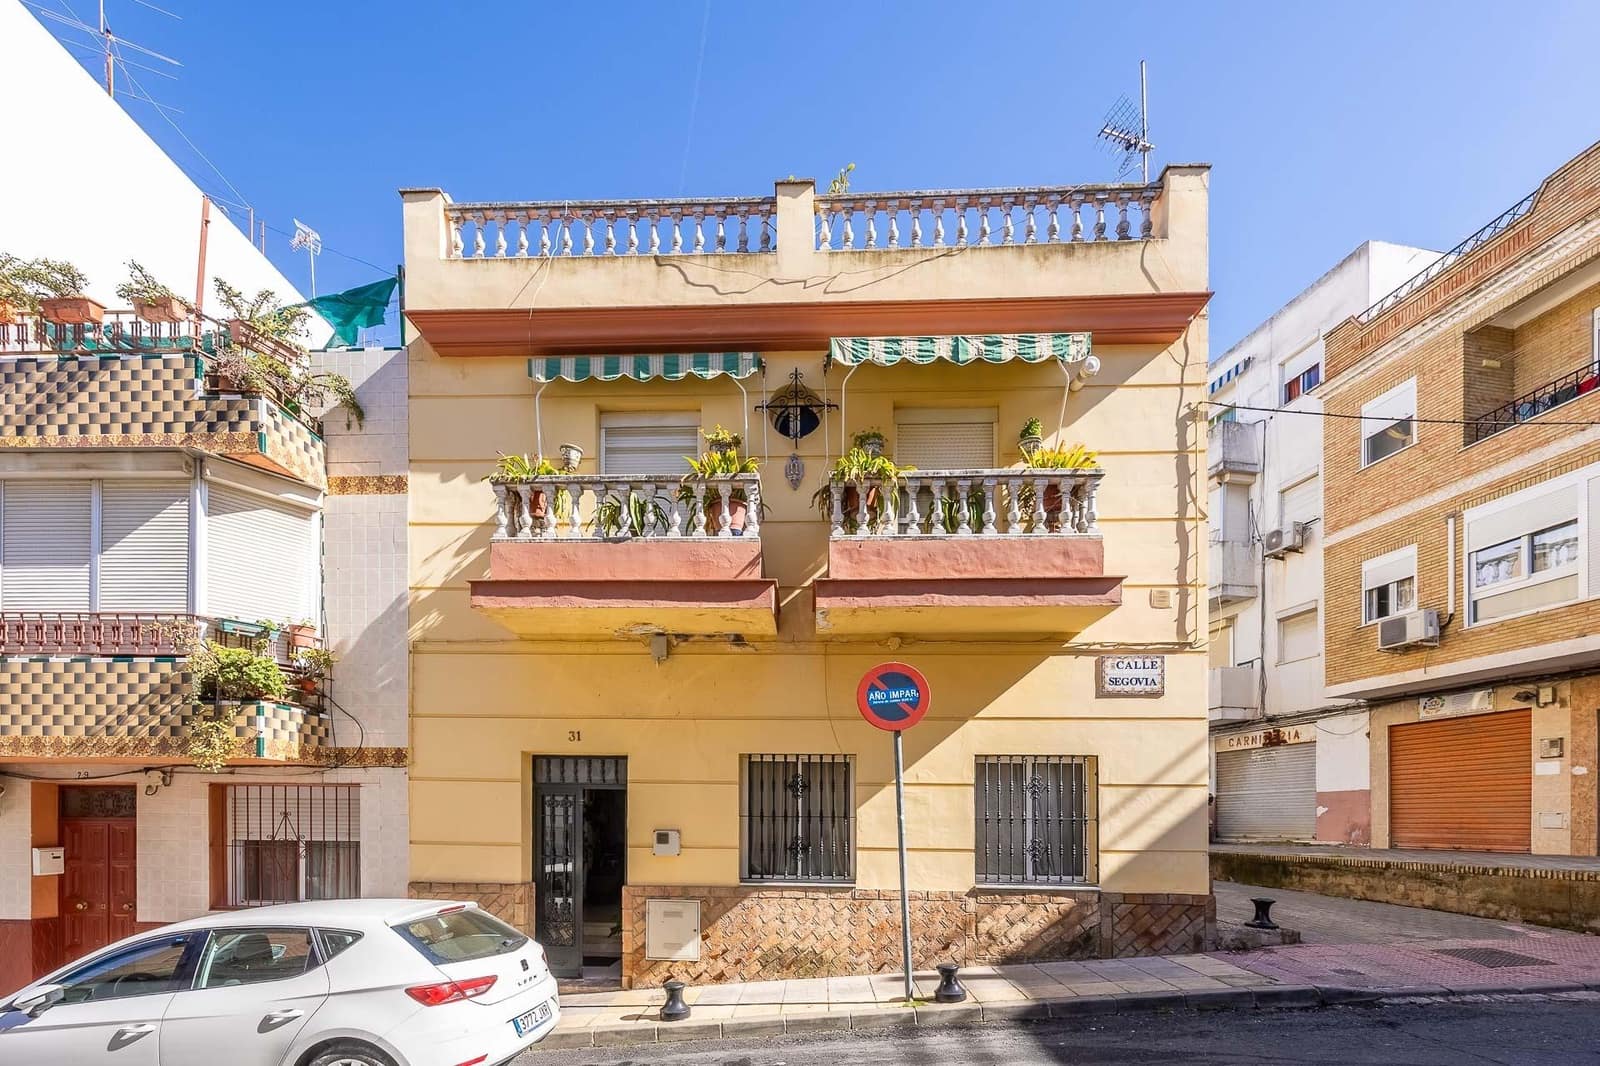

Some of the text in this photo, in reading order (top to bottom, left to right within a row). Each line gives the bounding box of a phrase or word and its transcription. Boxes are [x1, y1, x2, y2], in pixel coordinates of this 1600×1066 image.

[1116, 660, 1158, 670] CALLE
[1108, 677, 1157, 686] SEGOVIA
[568, 730, 581, 742] 31
[520, 1011, 538, 1030] 3772
